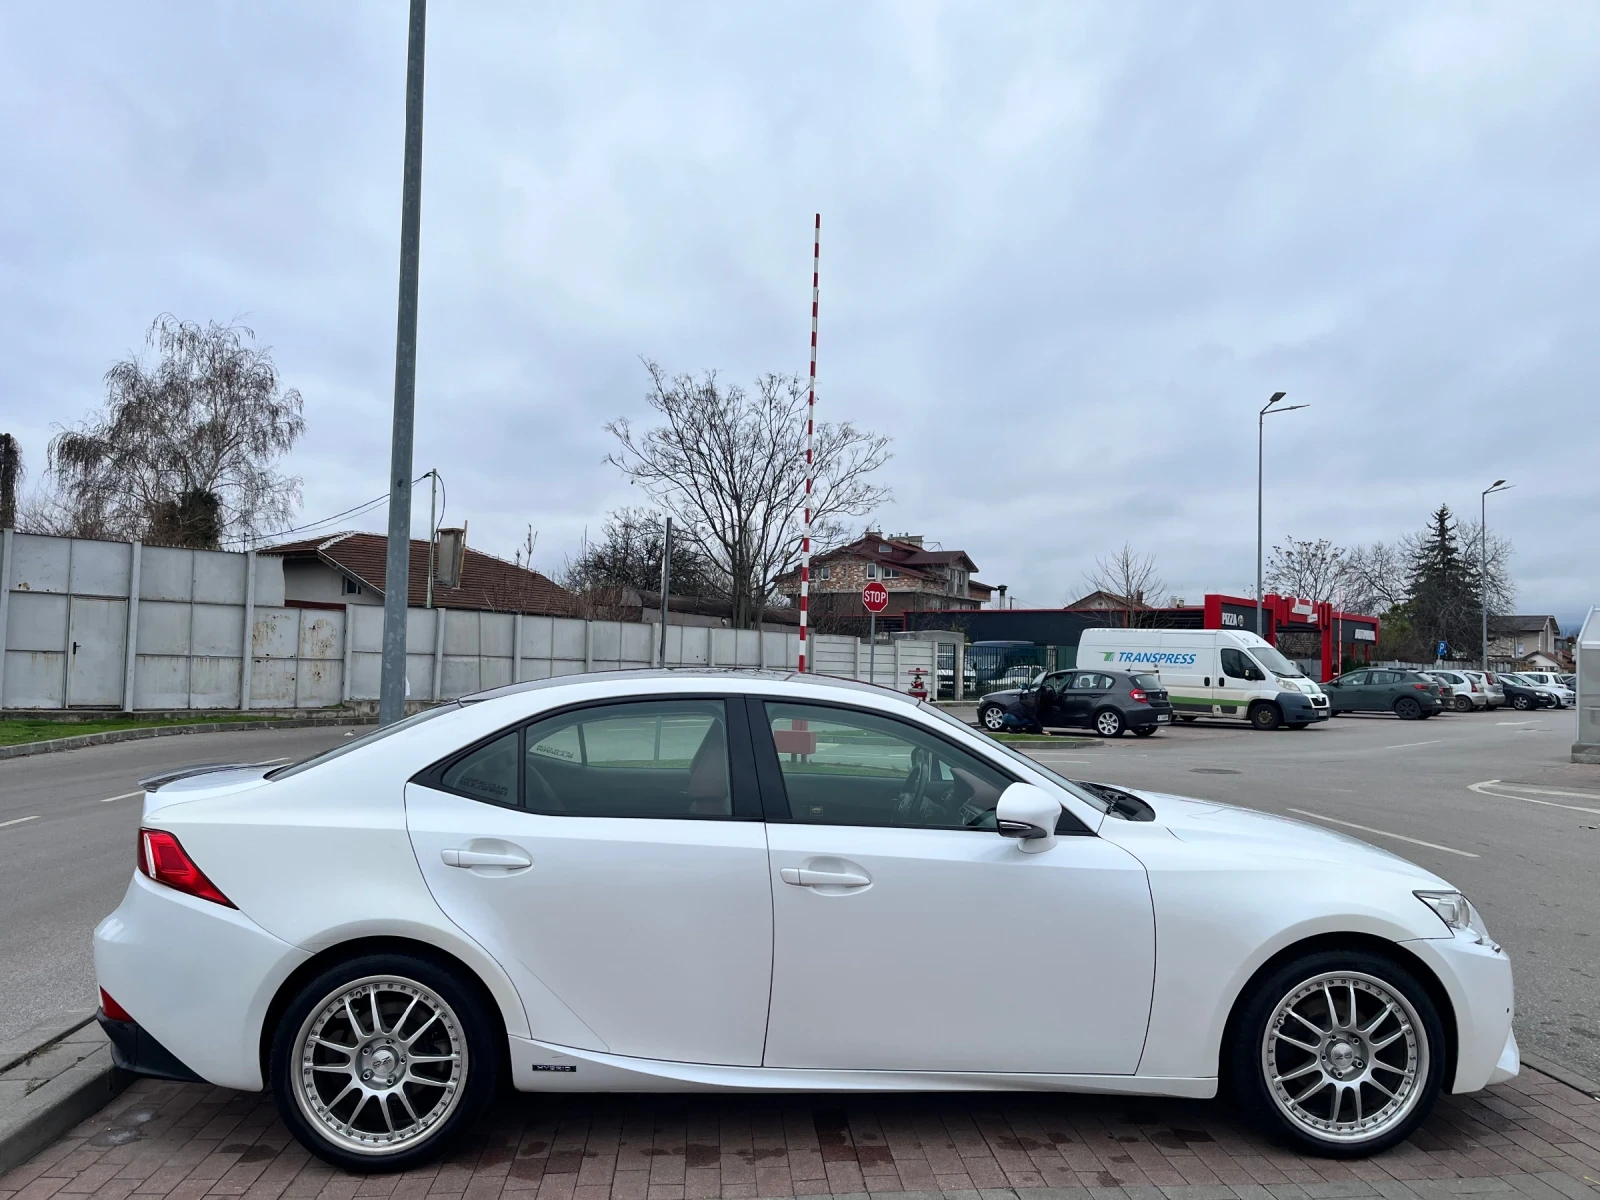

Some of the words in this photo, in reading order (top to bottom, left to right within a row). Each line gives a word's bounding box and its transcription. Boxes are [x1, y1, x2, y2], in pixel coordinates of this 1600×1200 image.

[864, 590, 887, 603] STOP
[1221, 612, 1238, 627] PIZZA
[1118, 651, 1196, 665] TRANSPRESS
